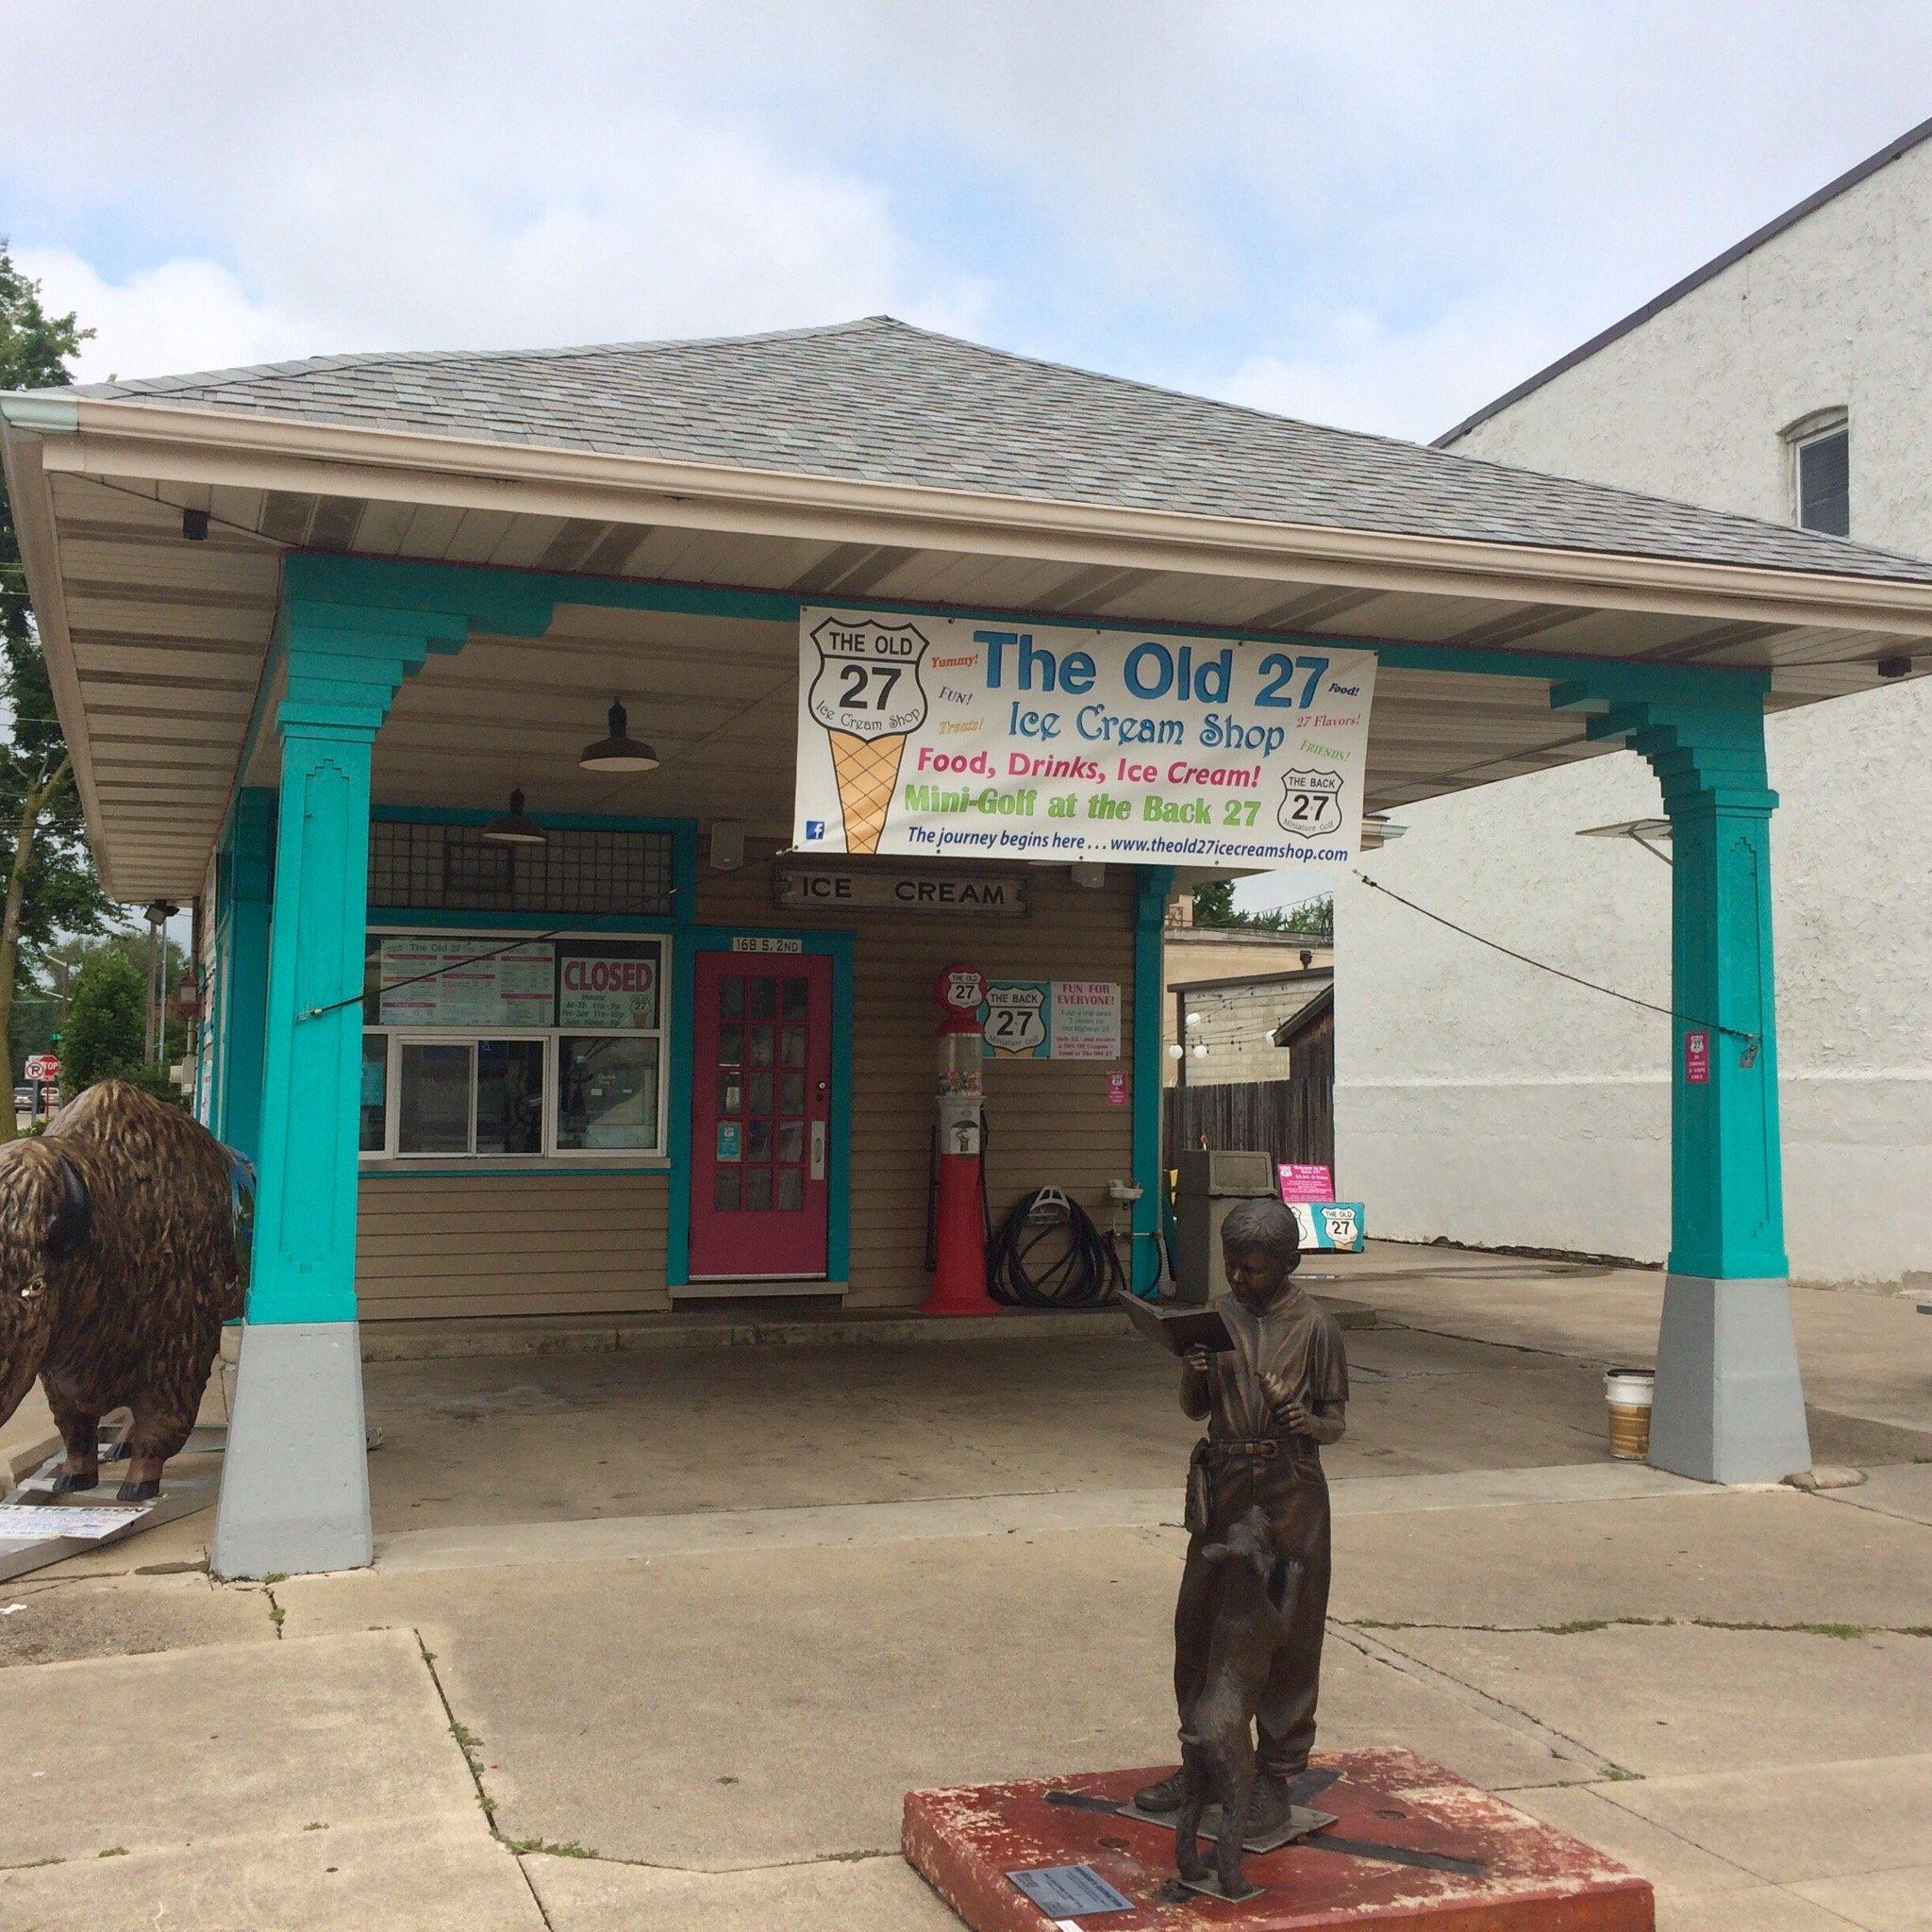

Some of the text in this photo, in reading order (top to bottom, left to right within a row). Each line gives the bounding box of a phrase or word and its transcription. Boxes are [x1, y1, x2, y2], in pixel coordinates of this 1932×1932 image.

[829, 631, 913, 656] THE OLD
[931, 653, 979, 669] Yummy!
[974, 630, 1330, 708] The Old 27
[839, 664, 902, 710] 27
[939, 686, 974, 706] FUN!
[1328, 682, 1360, 697] Food!
[815, 700, 921, 731] Ice Cream Shop
[1295, 714, 1361, 728] 27 Flavors!
[1008, 700, 1286, 759] Ice Cream Shop
[1299, 740, 1351, 763] FRIENDS!
[917, 747, 1262, 789] Food, Drinks, Ice Cream!
[1289, 776, 1336, 790] THE BACK
[905, 784, 1262, 827] Mini-Golf at the Back 27
[1291, 793, 1330, 822] 27
[908, 826, 936, 843] The
[936, 827, 998, 851] journey
[1000, 830, 1049, 851] begins
[1110, 837, 1349, 864] www.theold27icecreamshop.com
[803, 875, 1006, 905] ICE CREAM
[762, 940, 773, 952] S.
[776, 940, 799, 952] 2ND
[563, 960, 653, 992] CLOSED
[956, 985, 975, 999] 27
[991, 993, 1039, 1004] THE BACK
[1058, 994, 1115, 1006] EVERYONE!
[1089, 984, 1110, 993] FOR
[634, 1003, 648, 1011] 27
[996, 1010, 1034, 1036] 27
[1332, 1221, 1350, 1235] 27
